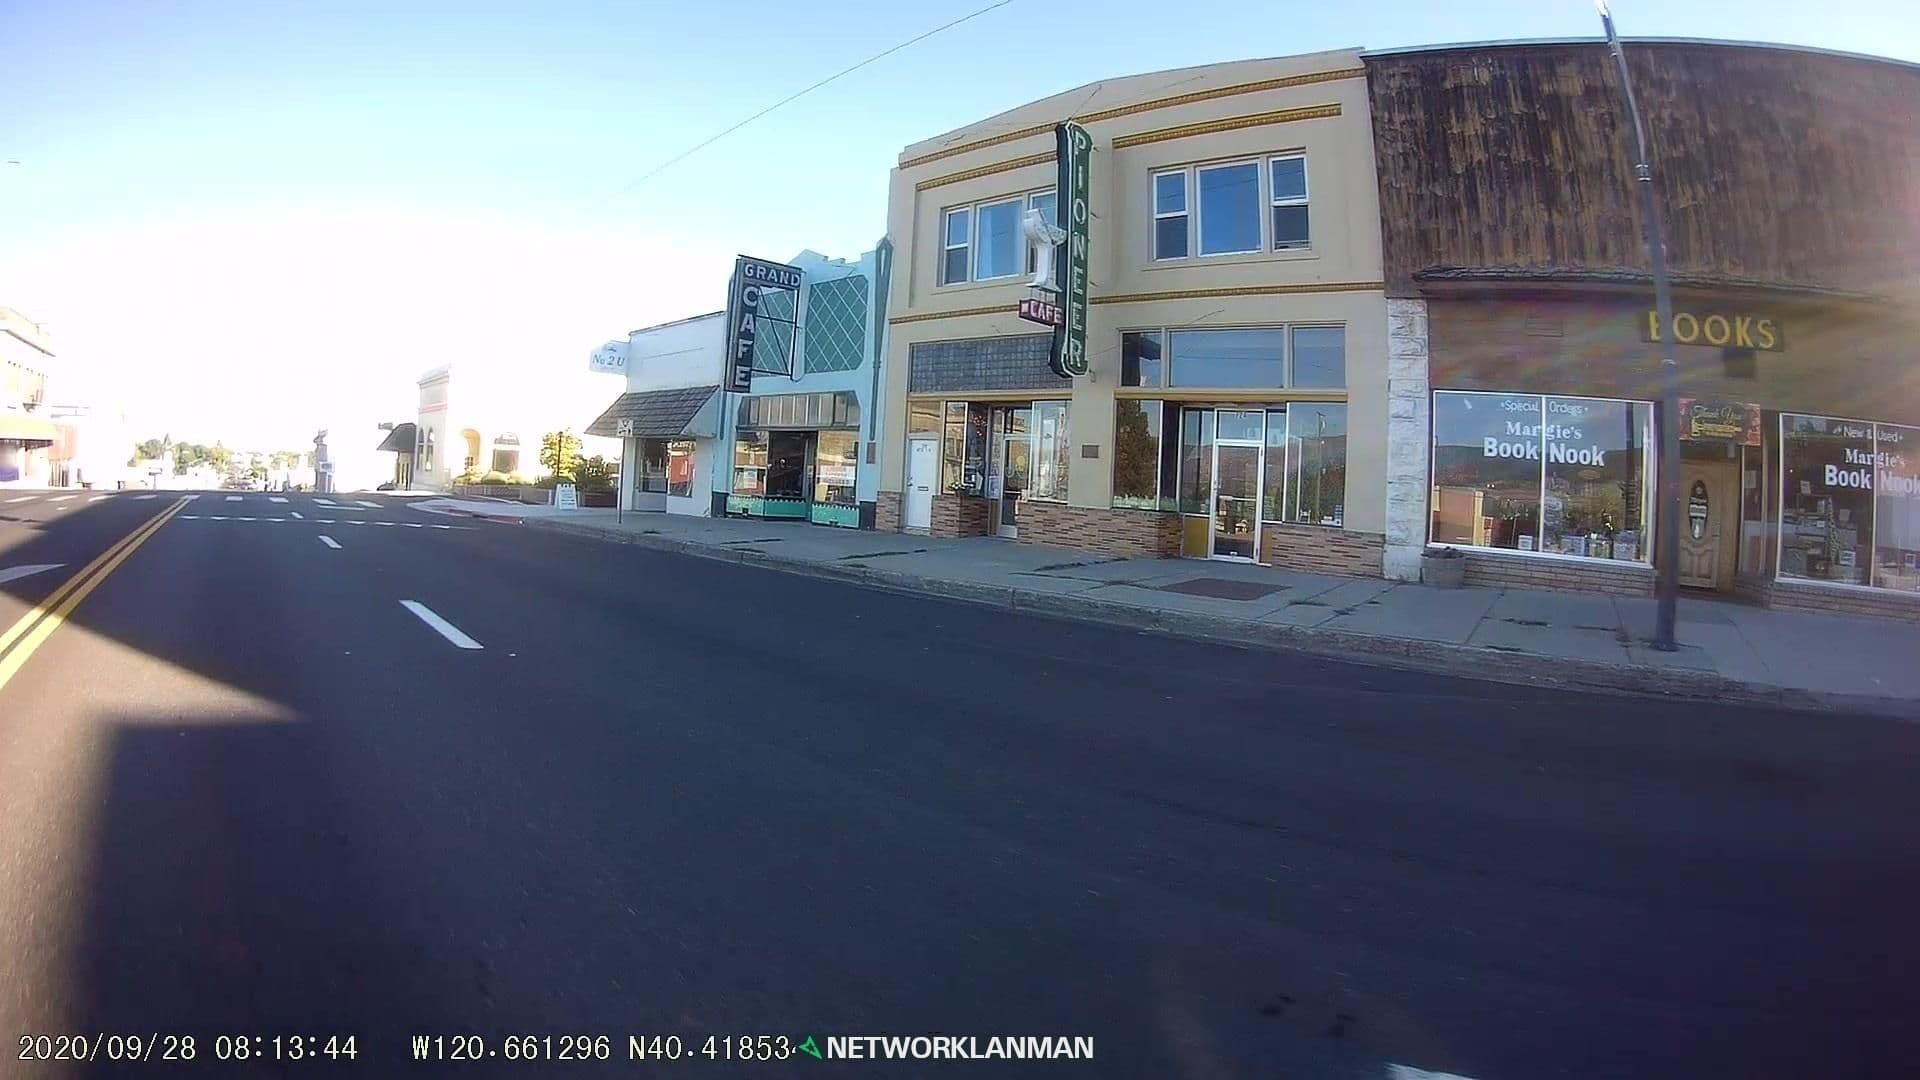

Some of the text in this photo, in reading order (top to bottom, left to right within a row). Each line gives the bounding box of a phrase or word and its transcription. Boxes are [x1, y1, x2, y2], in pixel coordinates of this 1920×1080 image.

[1068, 130, 1089, 367] PIONEER
[744, 263, 801, 286] GRAND
[1029, 302, 1063, 325] CAFE
[735, 286, 758, 387] CAFE
[1504, 399, 1583, 416] Special Orders
[1505, 420, 1583, 440] Margie's
[1842, 425, 1864, 439] New
[1876, 430, 1899, 443] Used
[1483, 436, 1606, 467] Book Nook
[1825, 464, 1873, 489] Book
